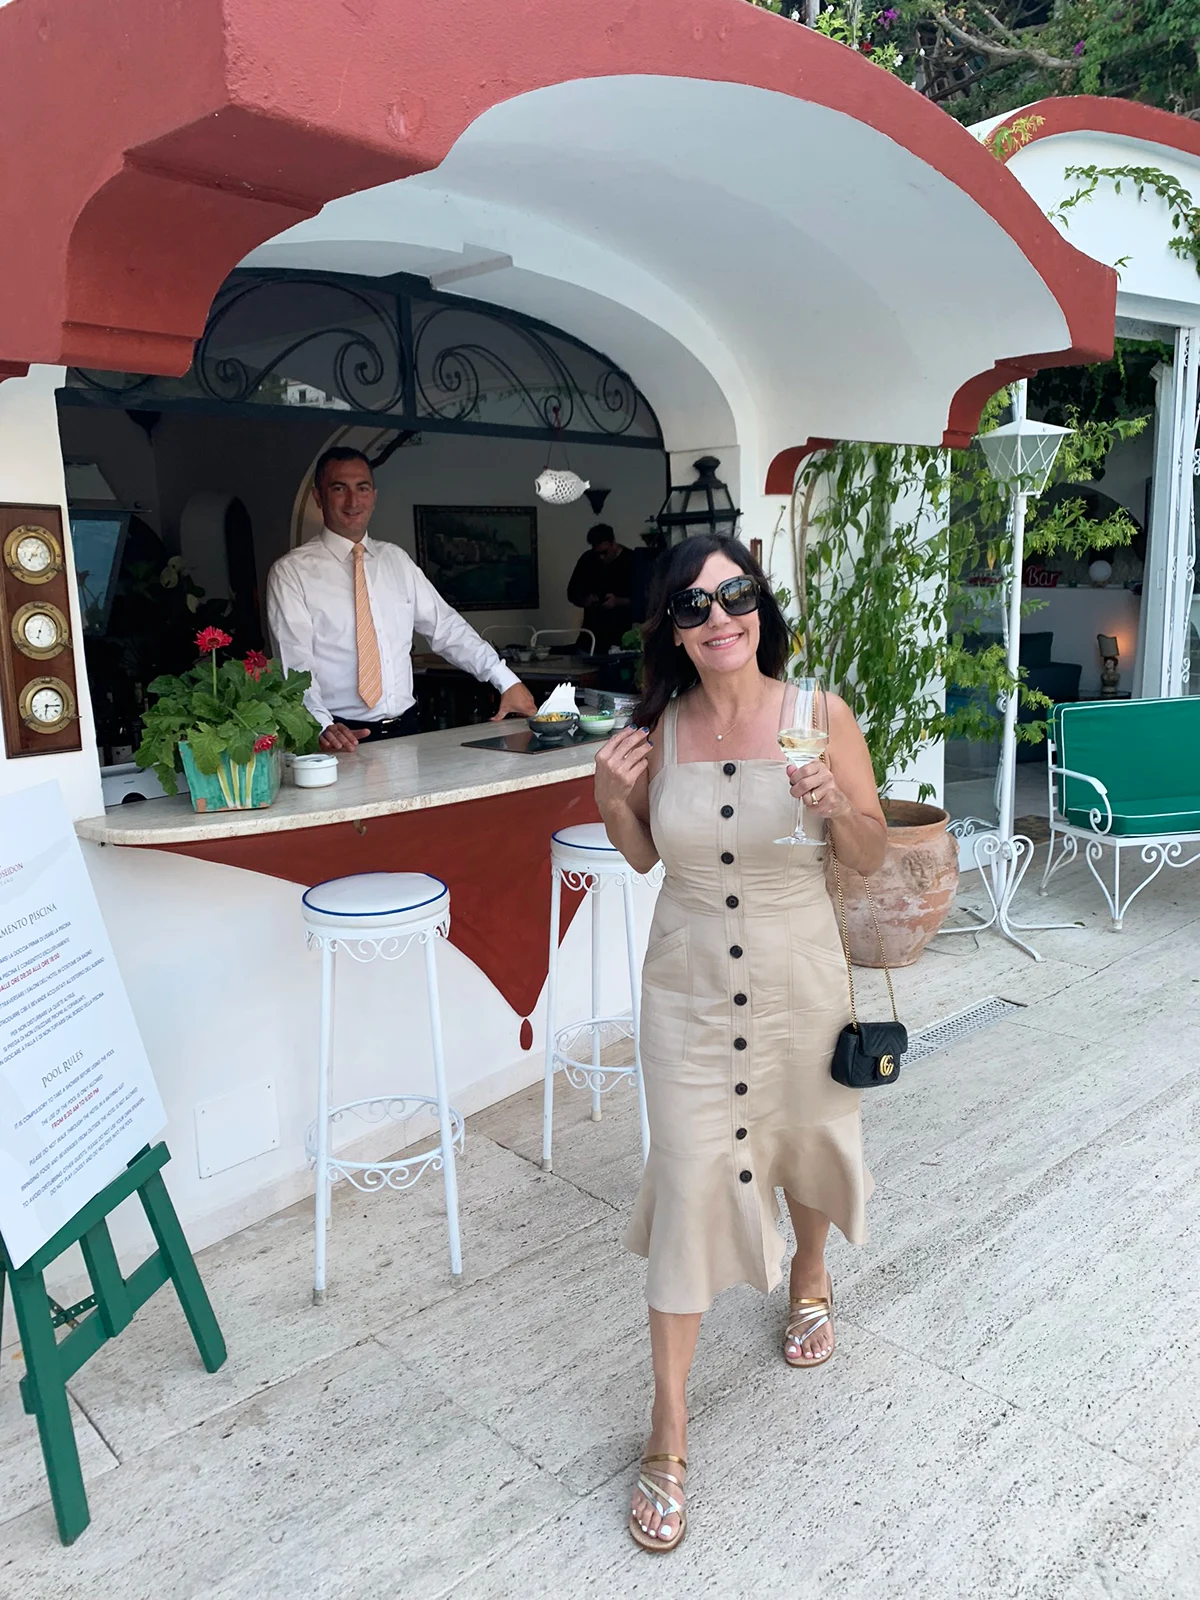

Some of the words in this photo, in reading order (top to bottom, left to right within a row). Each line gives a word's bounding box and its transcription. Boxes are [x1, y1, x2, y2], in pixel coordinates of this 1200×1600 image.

[1027, 565, 1059, 586] Bar
[29, 903, 57, 924] PISCINA
[42, 1066, 63, 1088] POOL
[62, 1050, 84, 1072] RULES
[51, 1116, 63, 1129] FROM
